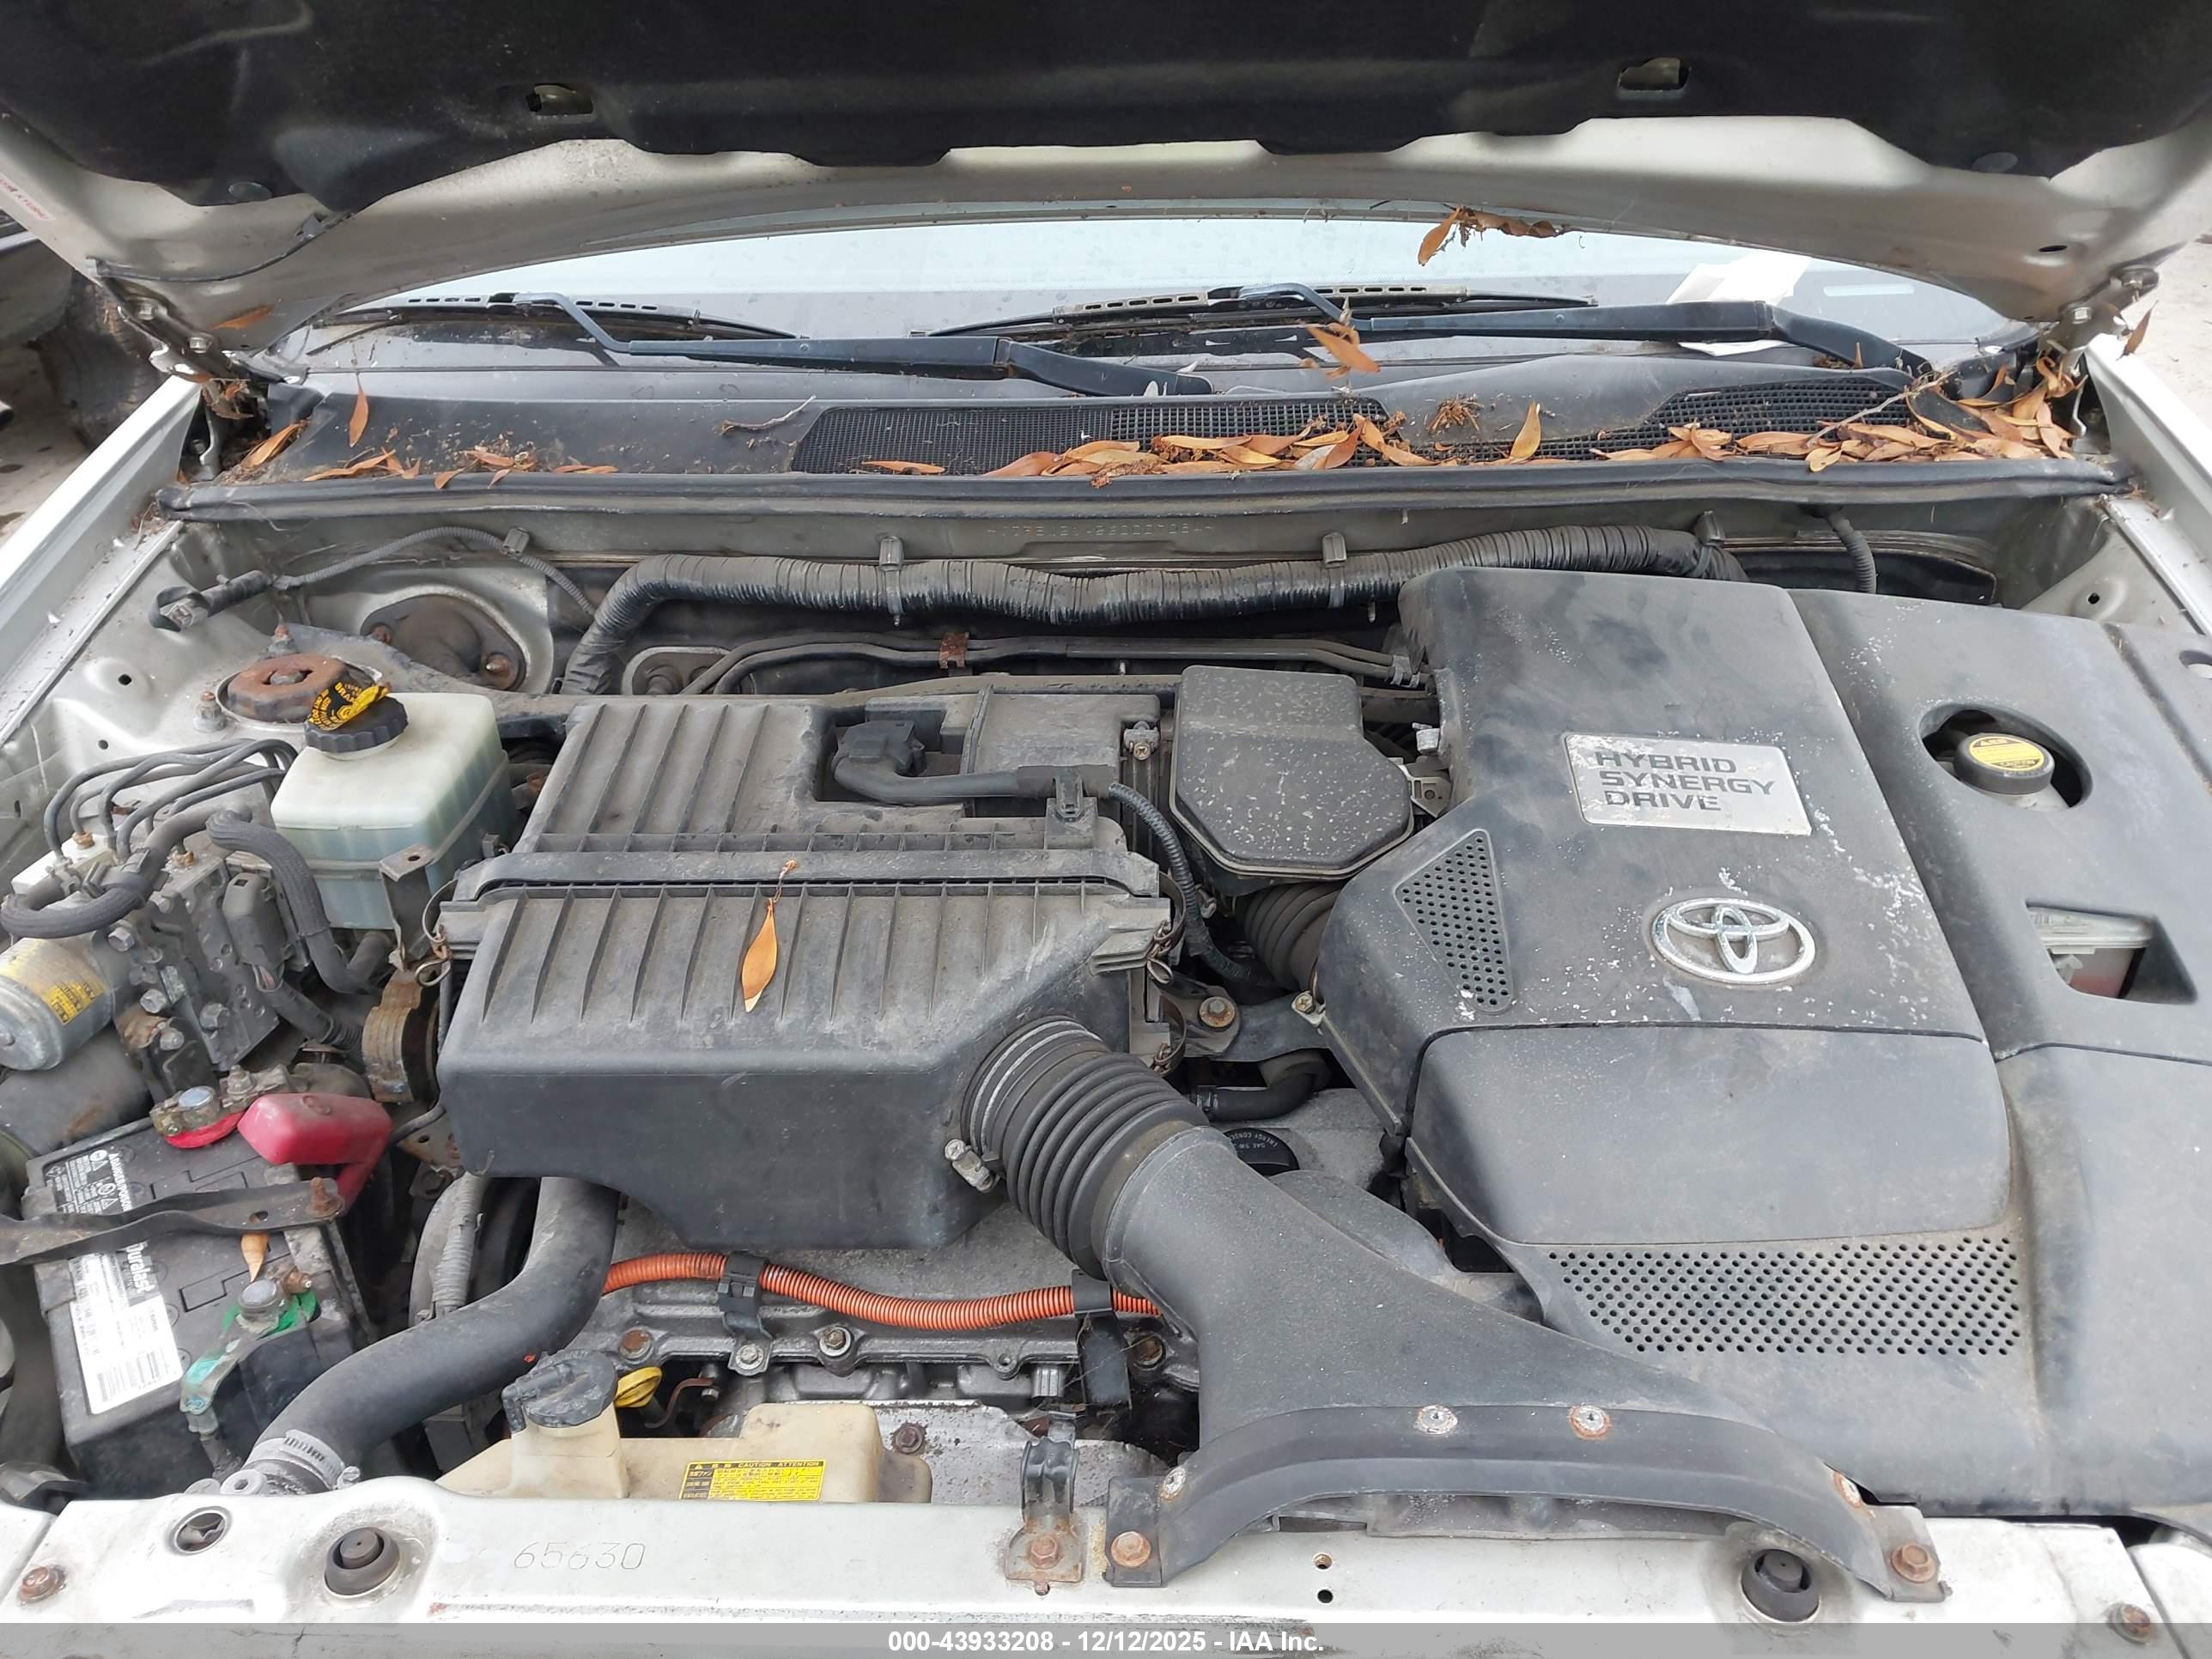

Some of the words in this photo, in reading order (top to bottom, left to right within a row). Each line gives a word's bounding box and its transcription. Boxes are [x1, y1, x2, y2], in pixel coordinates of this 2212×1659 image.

[1595, 751, 1737, 773] HYBRID
[1600, 771, 1775, 795] SYNERGY
[1605, 790, 1722, 811] DRIVE
[514, 1540, 646, 1570] 65630
